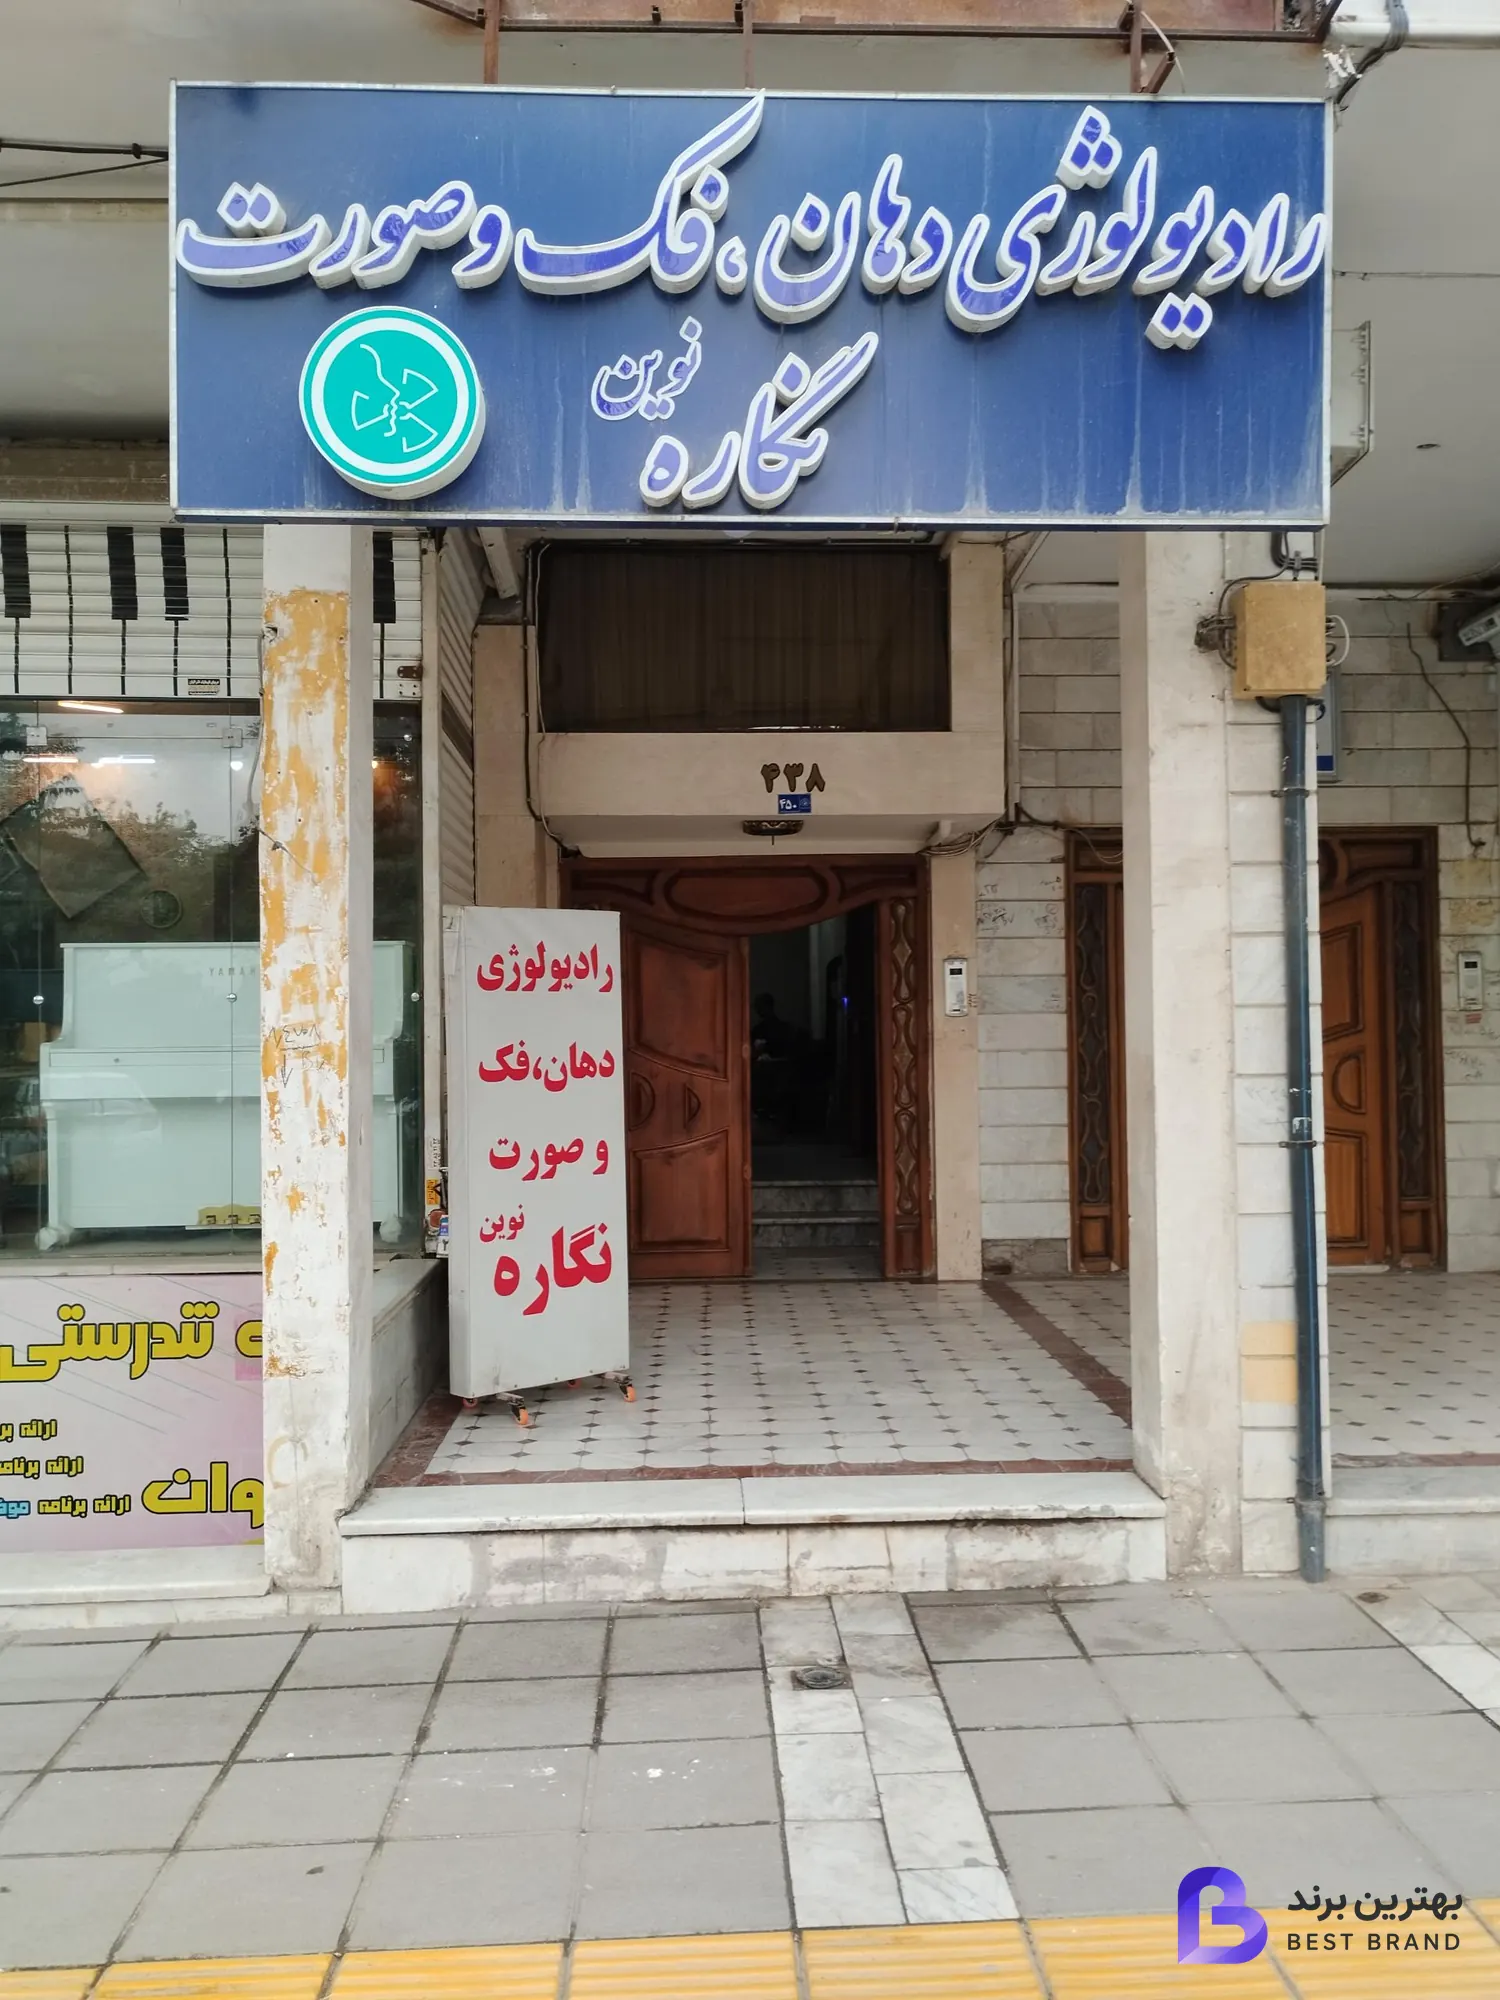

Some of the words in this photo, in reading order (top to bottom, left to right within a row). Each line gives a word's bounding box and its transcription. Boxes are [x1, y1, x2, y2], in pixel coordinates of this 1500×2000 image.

[176, 180, 476, 288] صورت
[515, 88, 765, 295] فک
[945, 104, 1328, 350] رادیولوژی
[452, 204, 512, 290] و
[591, 316, 703, 421] نوین
[639, 331, 880, 510] نگاره
[476, 940, 614, 993] رادیولوژی
[489, 1137, 585, 1182] صورت
[592, 1139, 609, 1175] و
[479, 1203, 525, 1243] نوین
[493, 1222, 613, 1317] نگاره
[37, 1496, 88, 1519] برنامه
